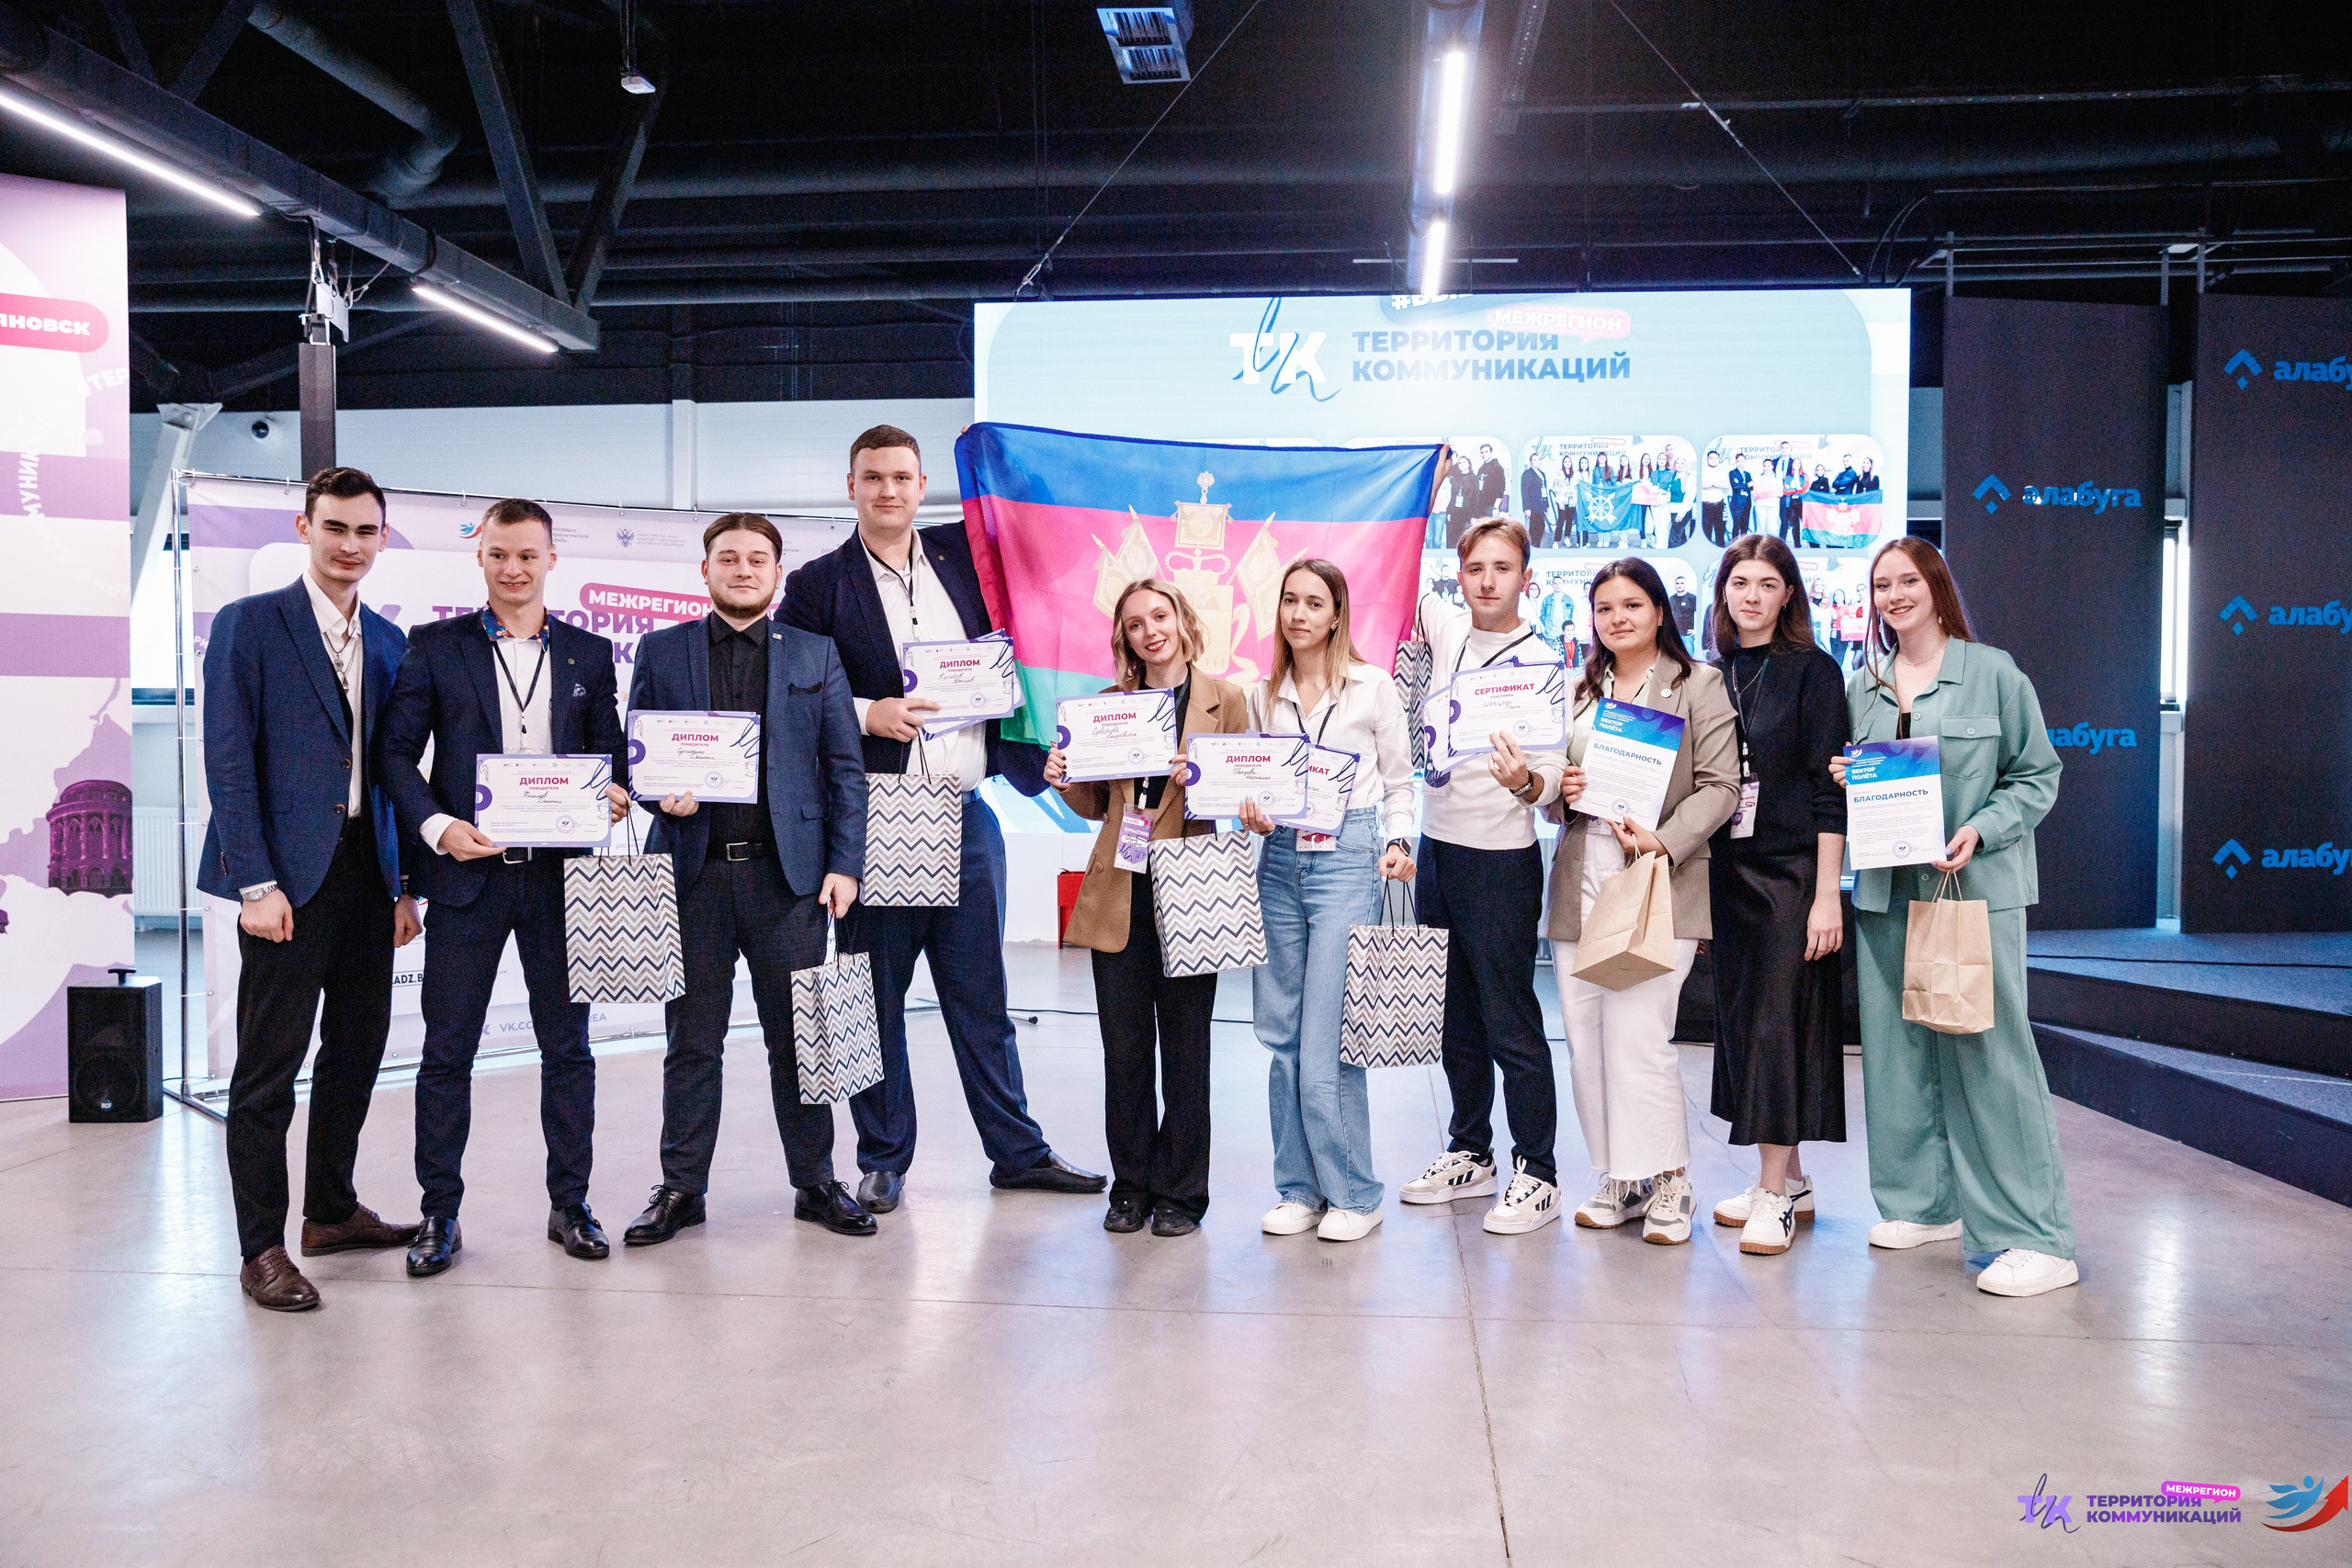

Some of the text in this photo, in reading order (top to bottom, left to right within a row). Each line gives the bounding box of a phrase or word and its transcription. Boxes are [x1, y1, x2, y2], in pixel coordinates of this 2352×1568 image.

[1494, 308, 1623, 333] МЕЖРЕГИОН
[1352, 330, 1559, 353] ТЕРРИТОРИЯ
[1352, 351, 1631, 383] КОММУНИКАЦИЙ
[2021, 479, 2143, 514] алабуга
[589, 589, 714, 616] МЕЖРЕГИОН
[939, 659, 980, 669] ДИПЛОМ
[1475, 682, 1535, 695] СЕРТИФИКАТ
[1092, 712, 1136, 723] ДИПЛОМ
[1600, 717, 1623, 727] ВЕКТОР
[1599, 723, 1623, 733] ПОЛЁТА
[672, 733, 718, 742] ДИПЛОМ
[1226, 755, 1272, 763] ДИПЛОМ
[1593, 742, 1662, 766] БЛАГОДАРНОСТЬ
[1851, 766, 1876, 774] ВЕКТОР
[519, 777, 569, 785] ДИПЛОМ
[1853, 788, 1928, 804] БЛАГОДАРНОСТЬ
